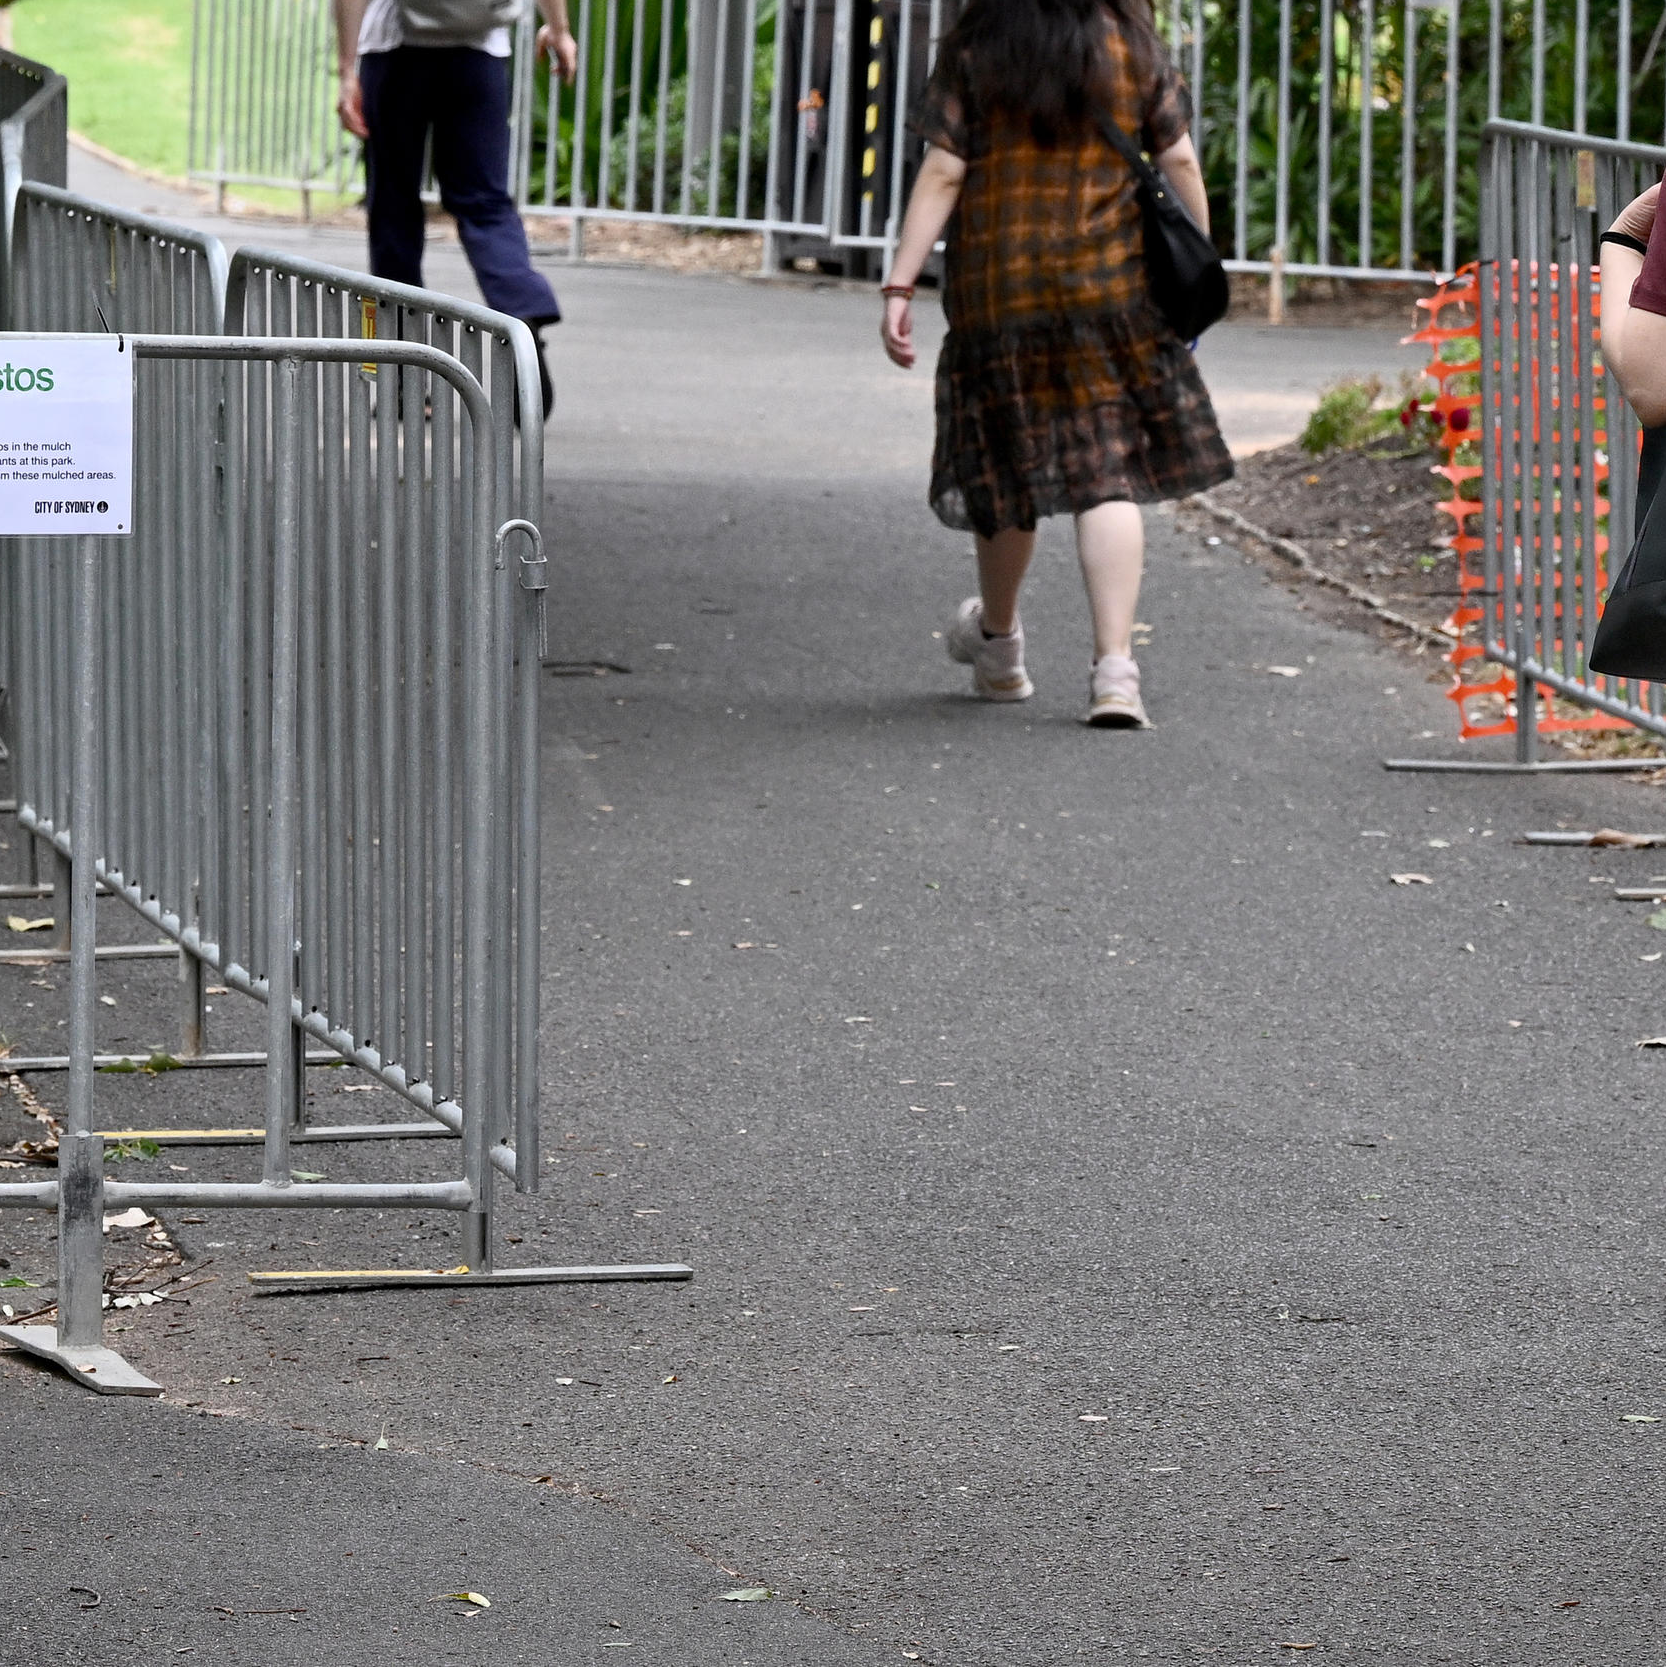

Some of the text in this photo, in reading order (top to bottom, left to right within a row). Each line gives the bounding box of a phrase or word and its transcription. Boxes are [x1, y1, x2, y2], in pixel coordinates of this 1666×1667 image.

[12, 442, 21, 452] in
[23, 442, 39, 452] the
[41, 442, 71, 452] mulch
[20, 457, 29, 466] at
[31, 457, 49, 466] this
[51, 457, 76, 468] park.
[13, 471, 39, 480] these
[42, 470, 84, 480] mulched
[87, 471, 116, 480] areas.
[35, 501, 95, 513] CITY OF SYDNEY
